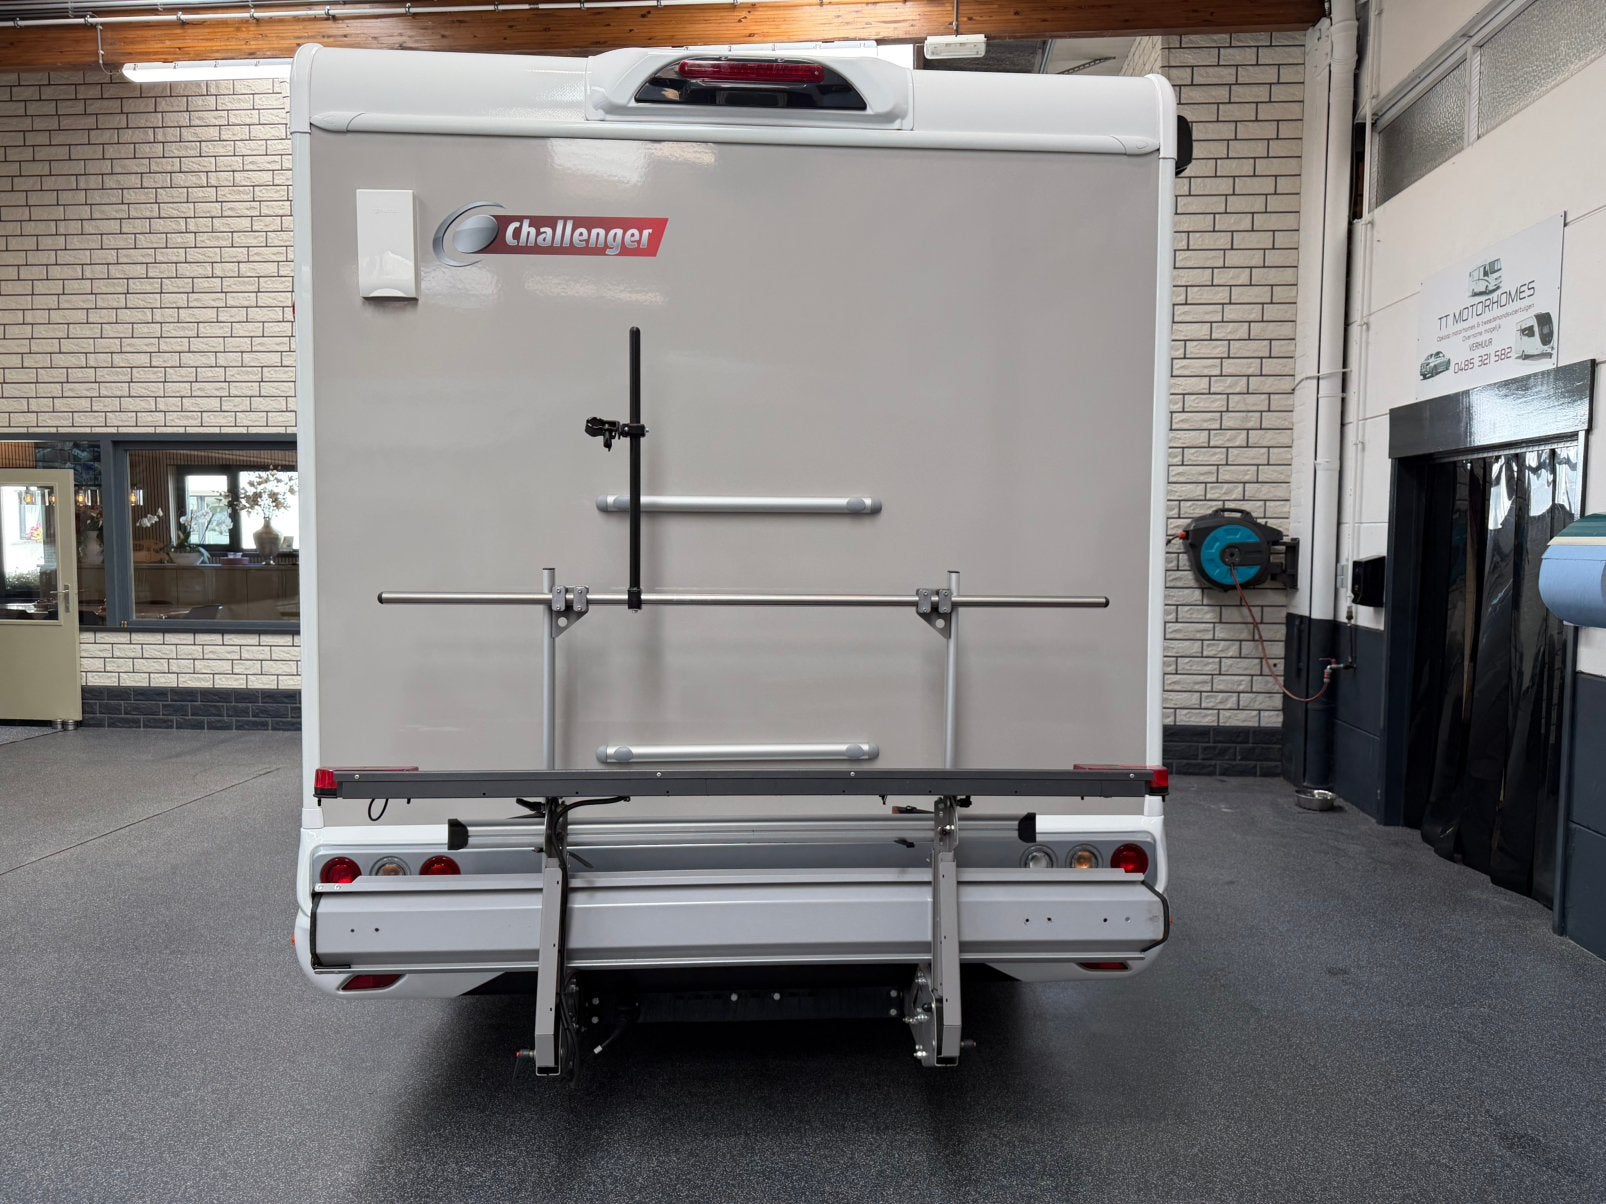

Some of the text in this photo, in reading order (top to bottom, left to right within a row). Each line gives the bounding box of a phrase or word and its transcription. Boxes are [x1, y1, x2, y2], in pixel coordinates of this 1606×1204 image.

[505, 218, 653, 255] Challenger
[1438, 280, 1535, 331] TT MOTORHOMES
[1454, 346, 1512, 374] 0485 321 582
[1469, 338, 1492, 351] VERHUUR
